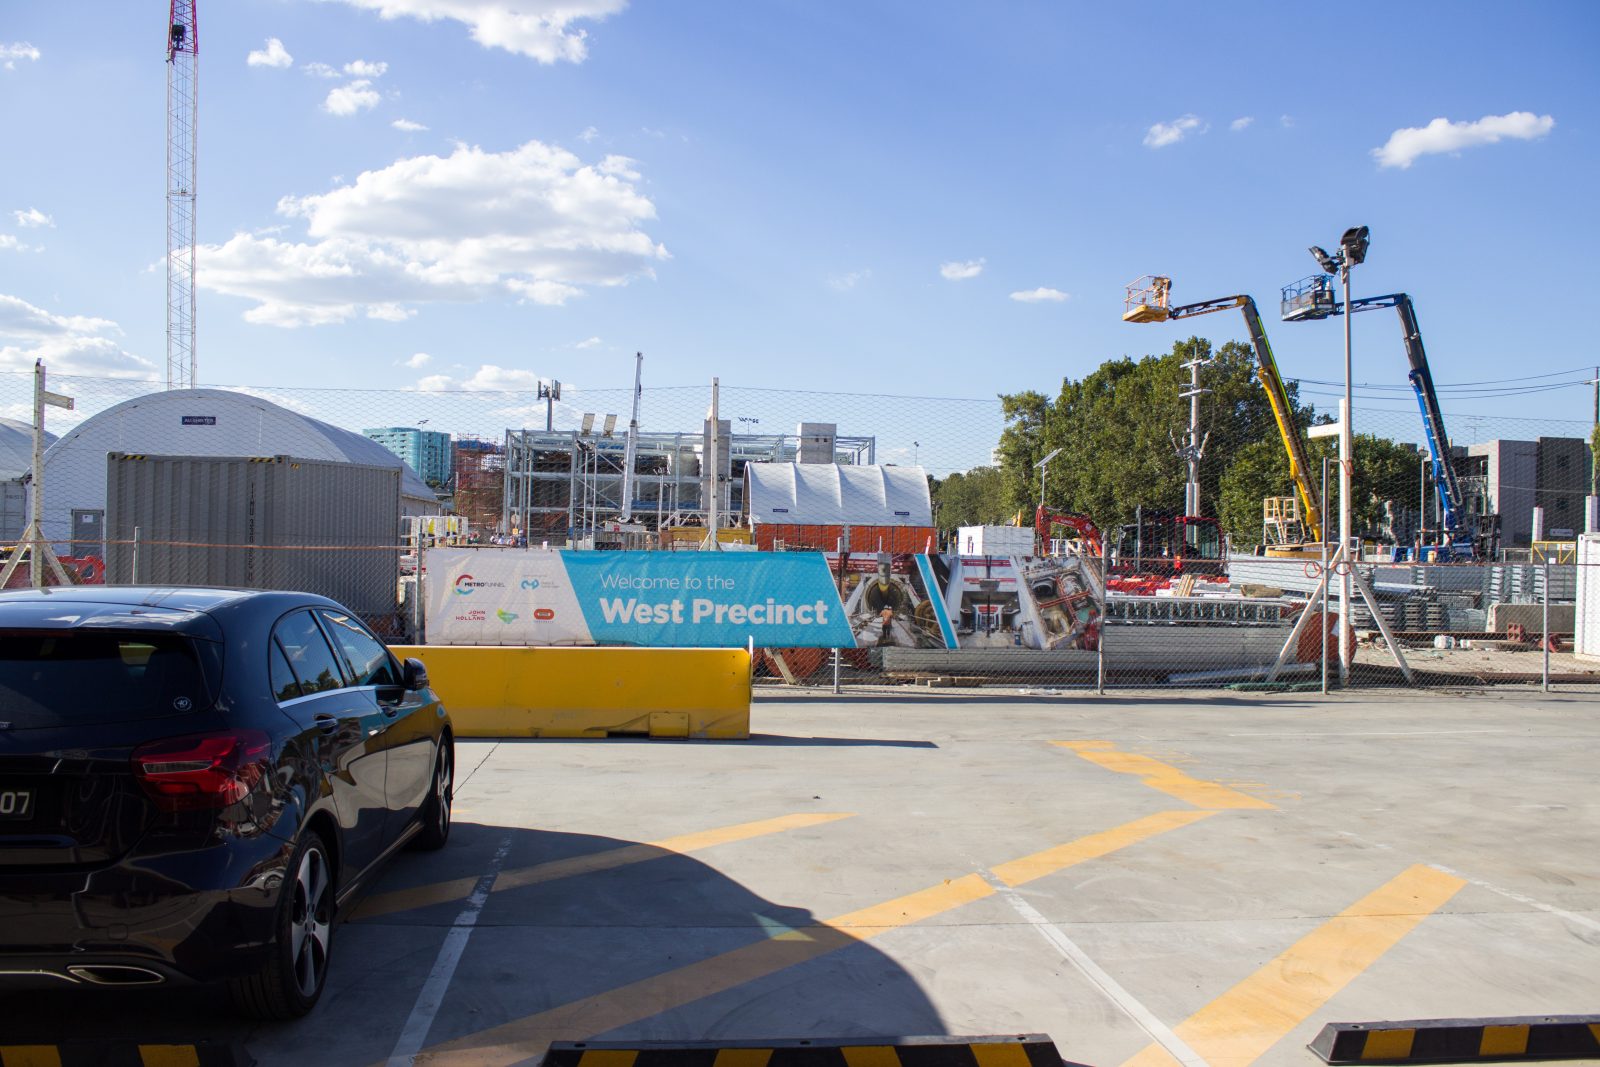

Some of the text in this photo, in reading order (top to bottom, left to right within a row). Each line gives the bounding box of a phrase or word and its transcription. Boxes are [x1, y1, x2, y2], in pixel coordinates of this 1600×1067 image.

[600, 573, 735, 589] Welcome to the
[599, 597, 829, 625] West Precinct
